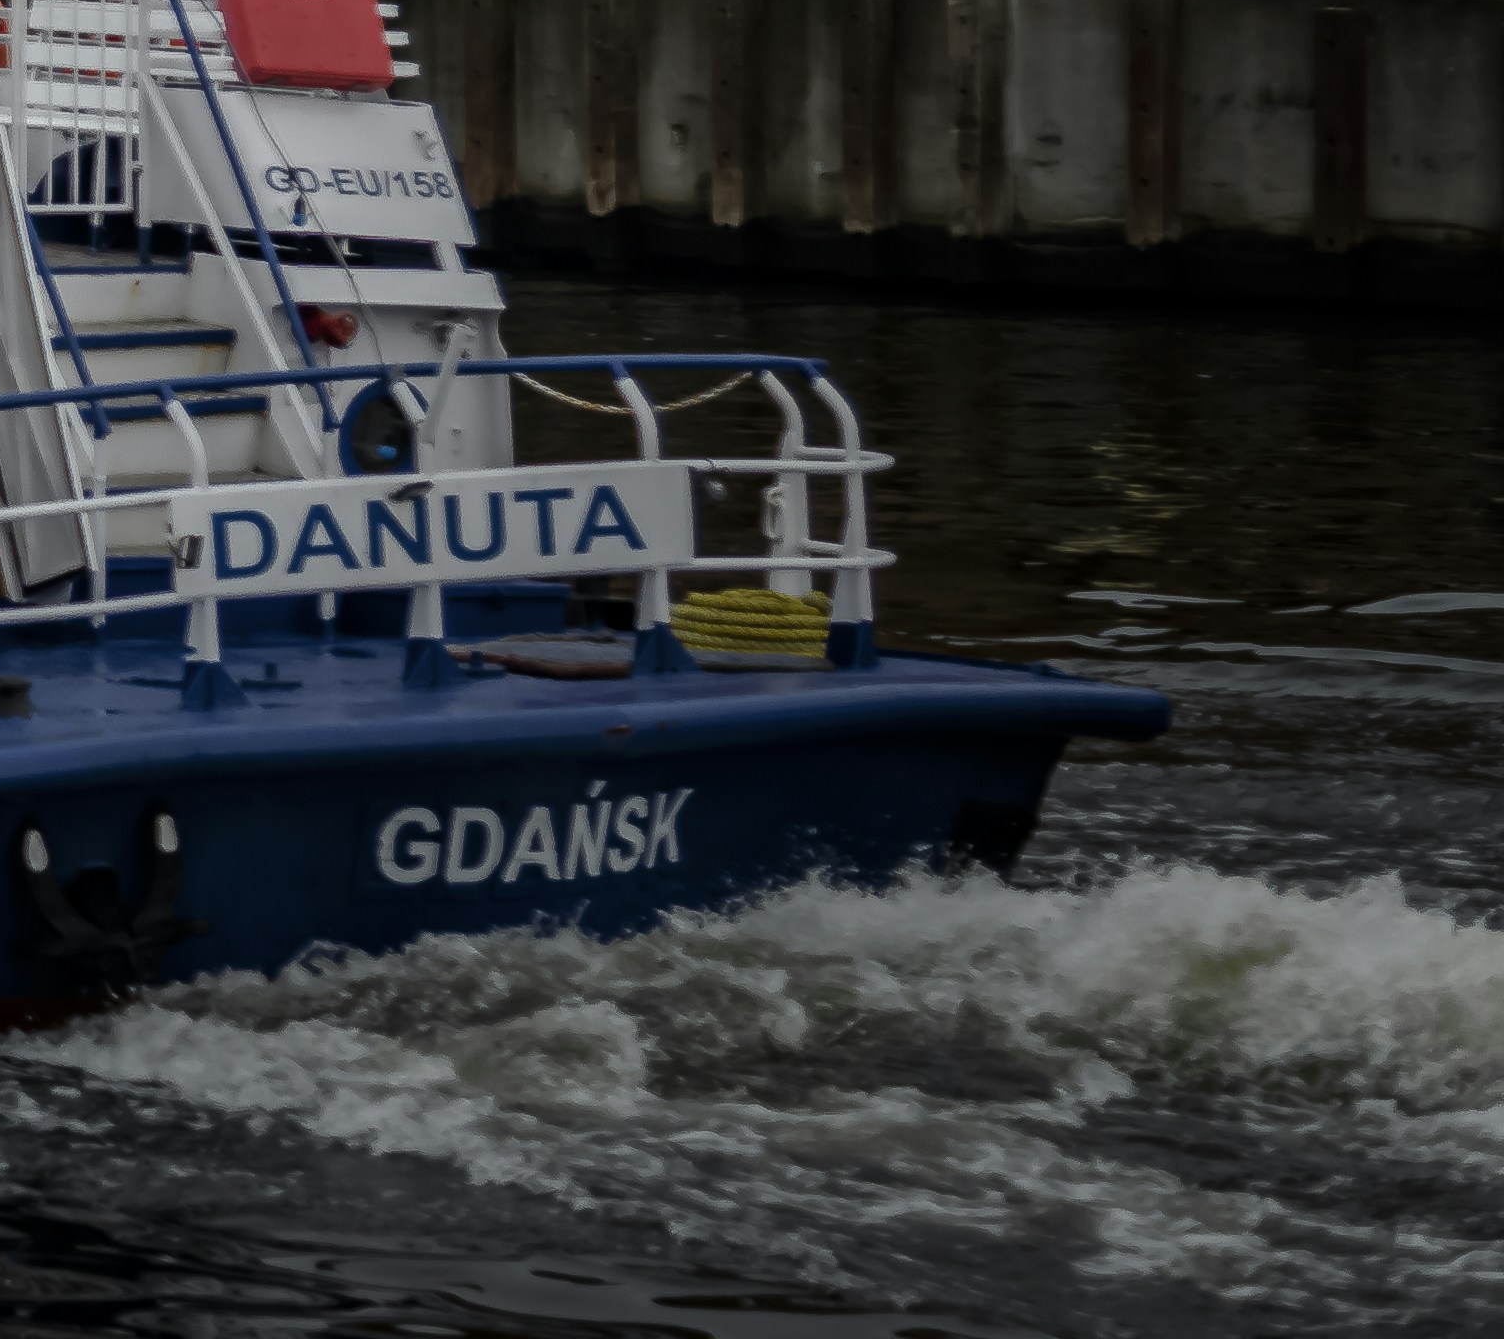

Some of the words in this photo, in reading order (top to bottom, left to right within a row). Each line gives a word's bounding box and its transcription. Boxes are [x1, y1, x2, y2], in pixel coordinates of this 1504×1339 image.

[265, 166, 454, 199] GD-EU/158
[211, 483, 647, 580] DANUTA
[374, 779, 695, 886] GDAŃSK
